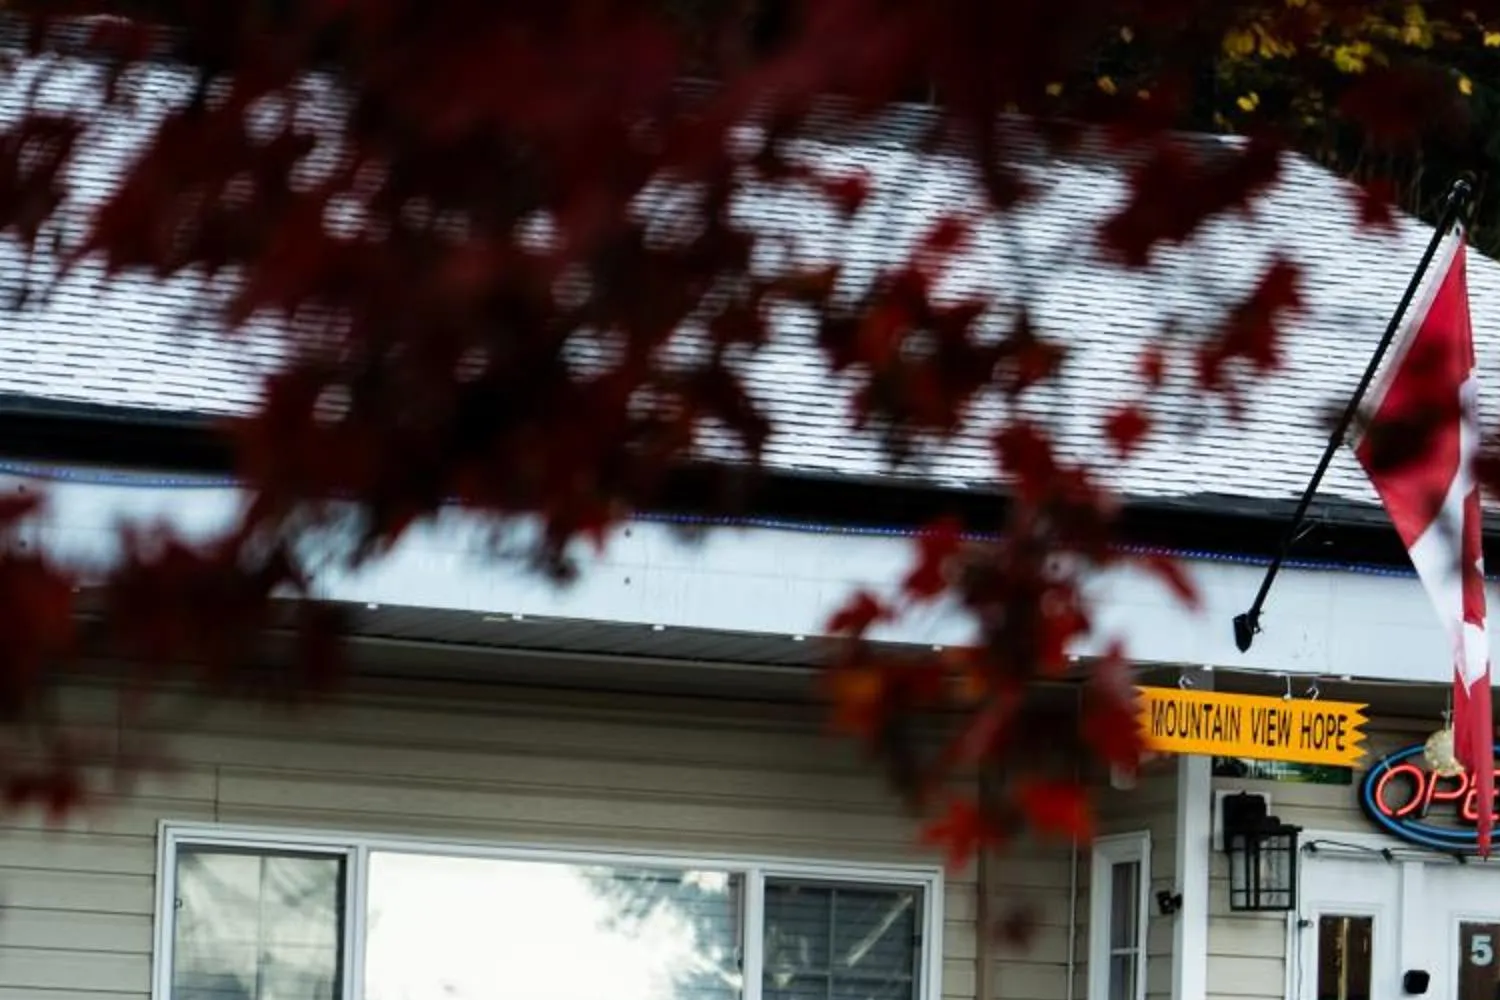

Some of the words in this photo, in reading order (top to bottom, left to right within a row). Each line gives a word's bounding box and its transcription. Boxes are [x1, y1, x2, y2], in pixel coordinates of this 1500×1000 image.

[1151, 699, 1242, 744] MOUNTAIN
[1251, 707, 1293, 749] VIEW
[1300, 711, 1349, 752] HOPE
